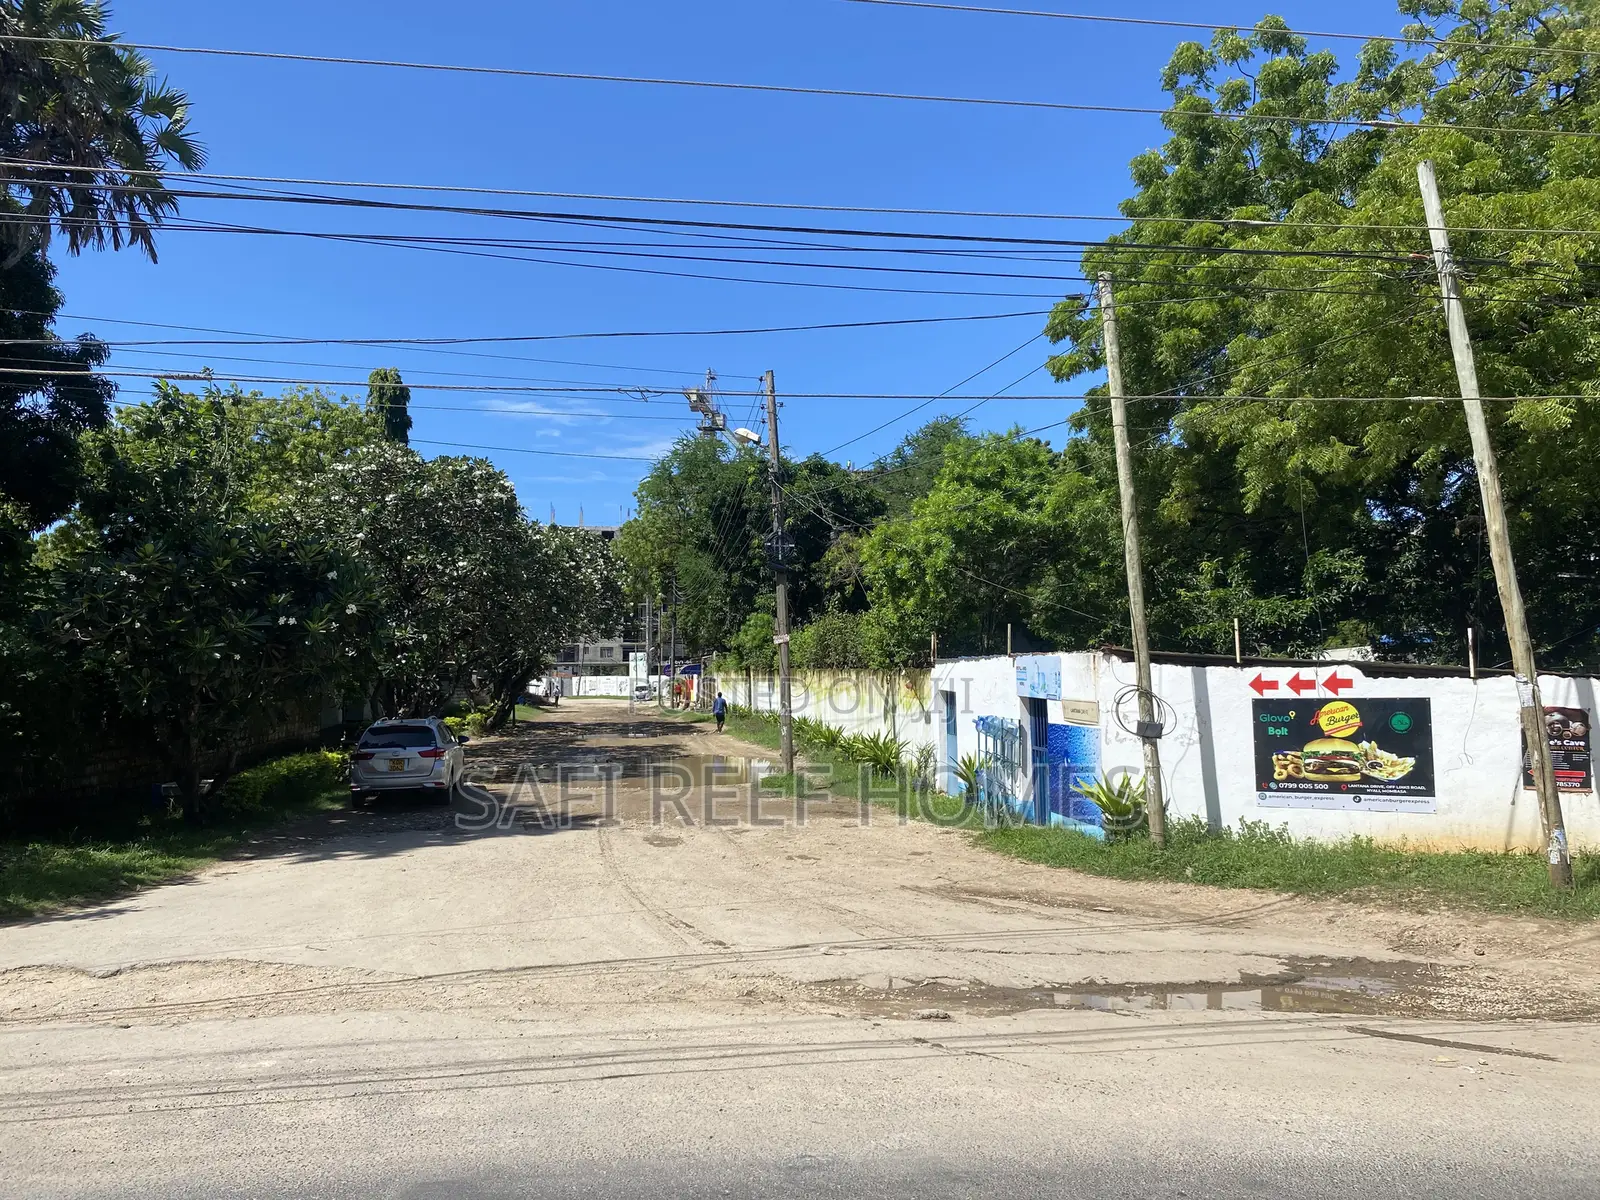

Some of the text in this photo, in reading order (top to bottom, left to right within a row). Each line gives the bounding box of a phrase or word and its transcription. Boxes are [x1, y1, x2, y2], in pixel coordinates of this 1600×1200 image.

[1259, 713, 1291, 723] Glovo
[1309, 705, 1349, 725] American
[1326, 712, 1360, 727] Burger
[1268, 726, 1289, 737] Bolt
